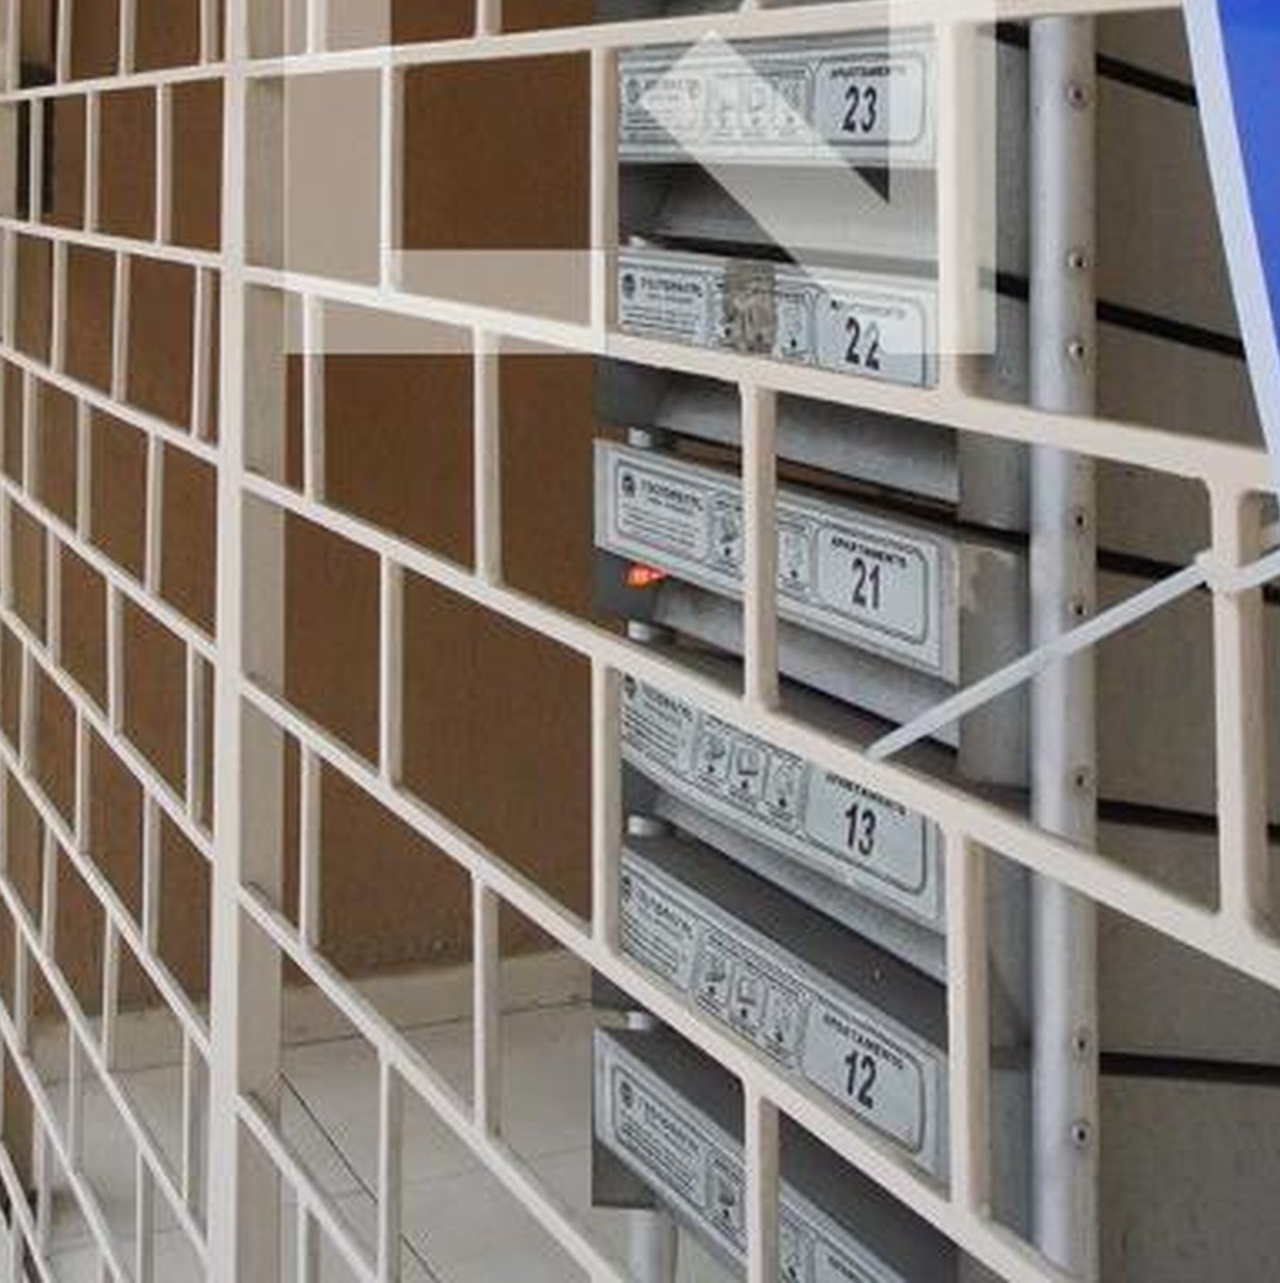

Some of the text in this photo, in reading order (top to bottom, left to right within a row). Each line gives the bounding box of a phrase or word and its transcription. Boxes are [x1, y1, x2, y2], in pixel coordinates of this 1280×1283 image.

[842, 85, 877, 133] 23
[845, 316, 880, 371] 22
[852, 557, 880, 609] 21
[845, 803, 877, 856] 13
[845, 1051, 876, 1110] 12
